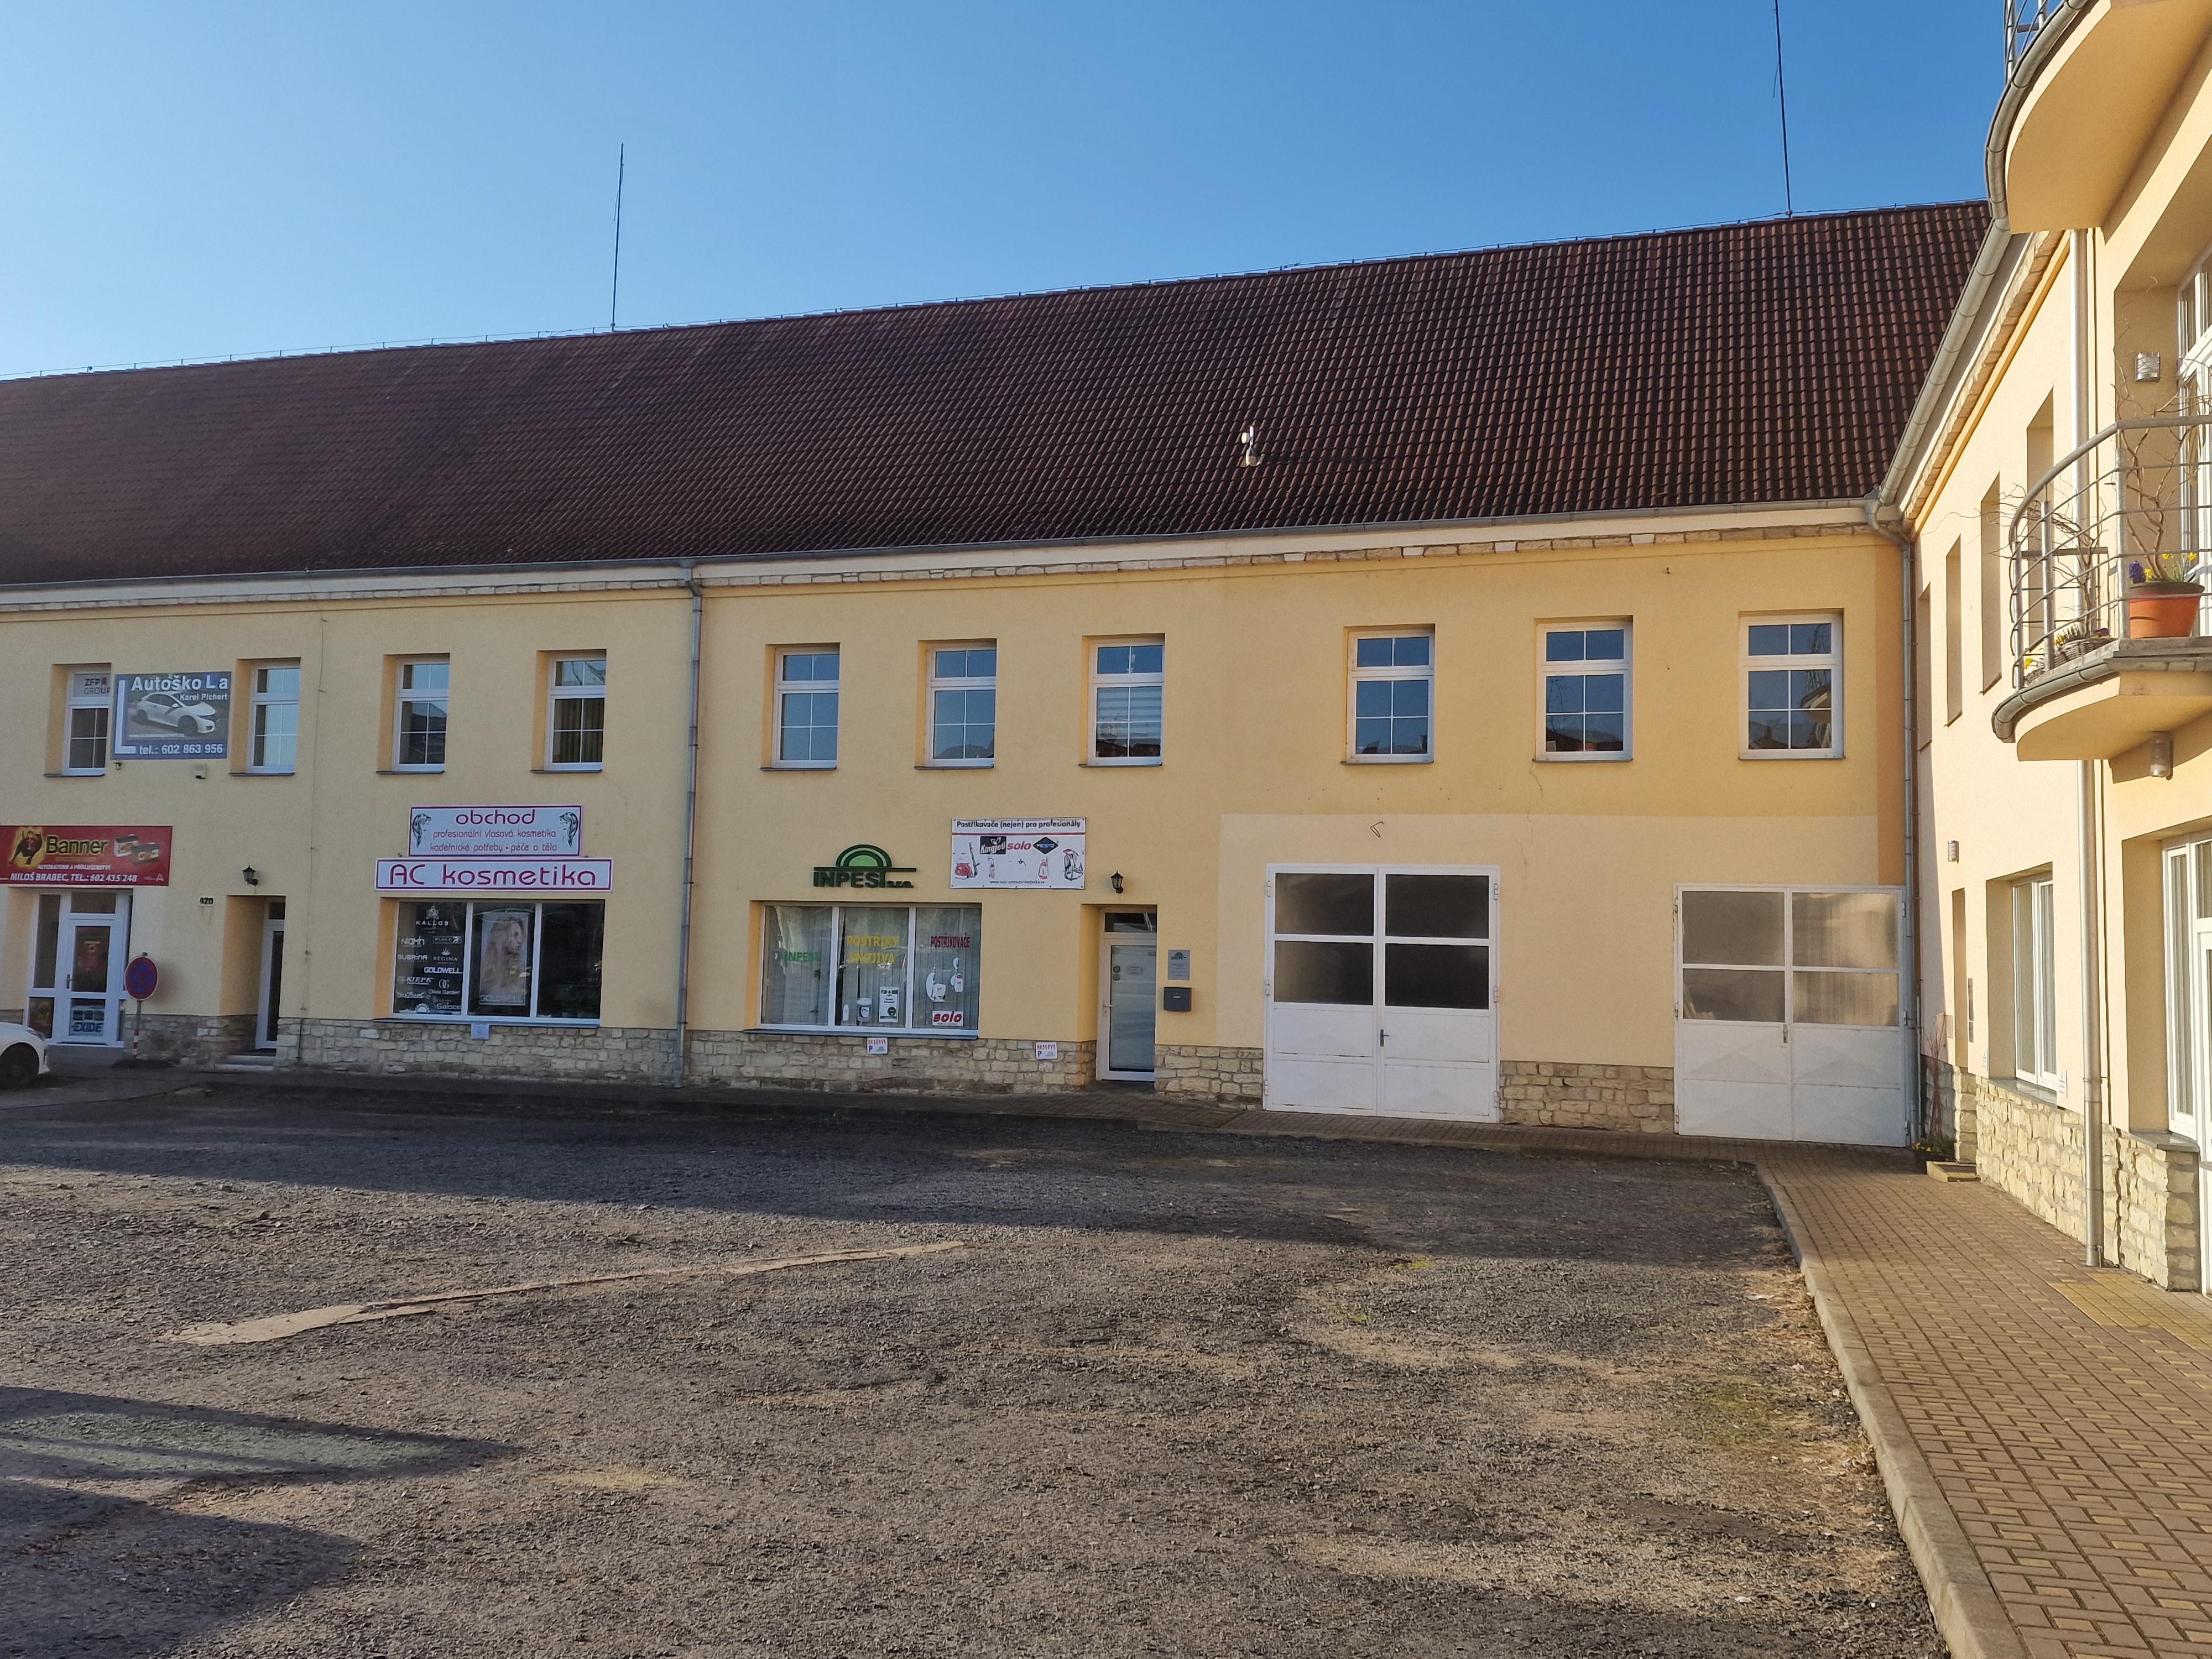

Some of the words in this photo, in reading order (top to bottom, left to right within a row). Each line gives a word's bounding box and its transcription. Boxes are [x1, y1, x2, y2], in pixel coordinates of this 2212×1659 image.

[139, 745, 158, 754] tel.:
[161, 744, 180, 754] 602
[183, 744, 201, 753] 863
[205, 743, 223, 753] 956
[456, 810, 535, 825] obchod
[1000, 821, 1023, 829] (nejen)
[1039, 820, 1081, 828] profesionály
[433, 830, 481, 839] profesionální
[485, 829, 513, 838] vlasová
[517, 829, 556, 838] kosmetika
[46, 835, 108, 855] Banner
[430, 843, 469, 852] kadeřnické
[473, 843, 503, 853] potřeby
[510, 844, 529, 853] péče
[542, 843, 557, 852] tělo
[1006, 841, 1031, 851] solo
[10, 872, 35, 881] MILOŠ
[35, 873, 69, 882] BRABEC,
[390, 863, 426, 885] AC
[442, 864, 597, 886] kosmetika
[813, 870, 886, 888] INPEST
[931, 933, 970, 948] POSTŘIKOVAČE
[933, 1011, 962, 1022] solo
[72, 1022, 102, 1032] EXIDE
